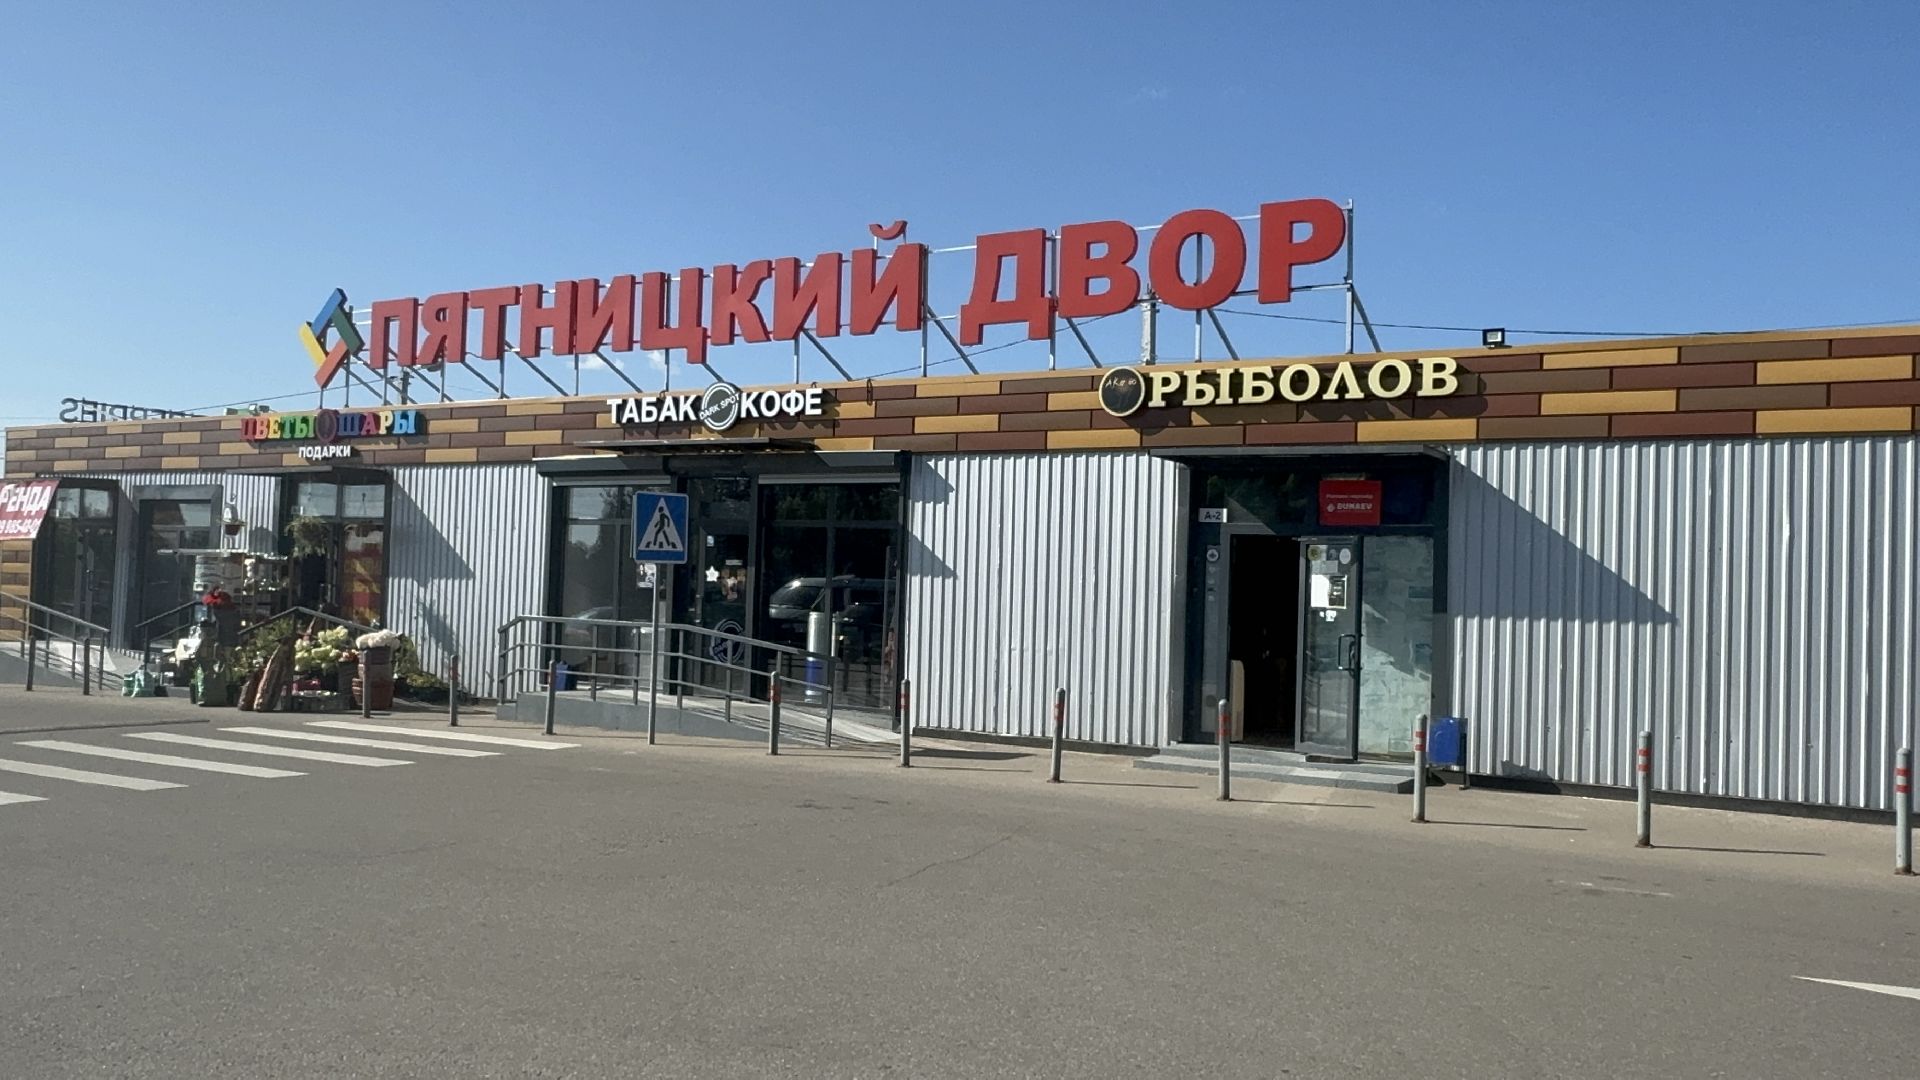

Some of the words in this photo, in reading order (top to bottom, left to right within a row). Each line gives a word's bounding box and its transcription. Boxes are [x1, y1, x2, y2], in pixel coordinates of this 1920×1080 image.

[369, 220, 925, 369] ПЯТНИЦКИЙ
[960, 198, 1347, 346] ДВОР
[1148, 357, 1459, 407] РЫБОЛОВ
[606, 395, 697, 424] ТАБАК
[740, 388, 823, 418] КОФЕ
[699, 403, 721, 420] DARK
[720, 393, 739, 409] SPOT
[240, 414, 316, 442] ЦВЕТЫ
[337, 410, 417, 436] ШАРЫ
[298, 445, 351, 461] ПОДАРКИ
